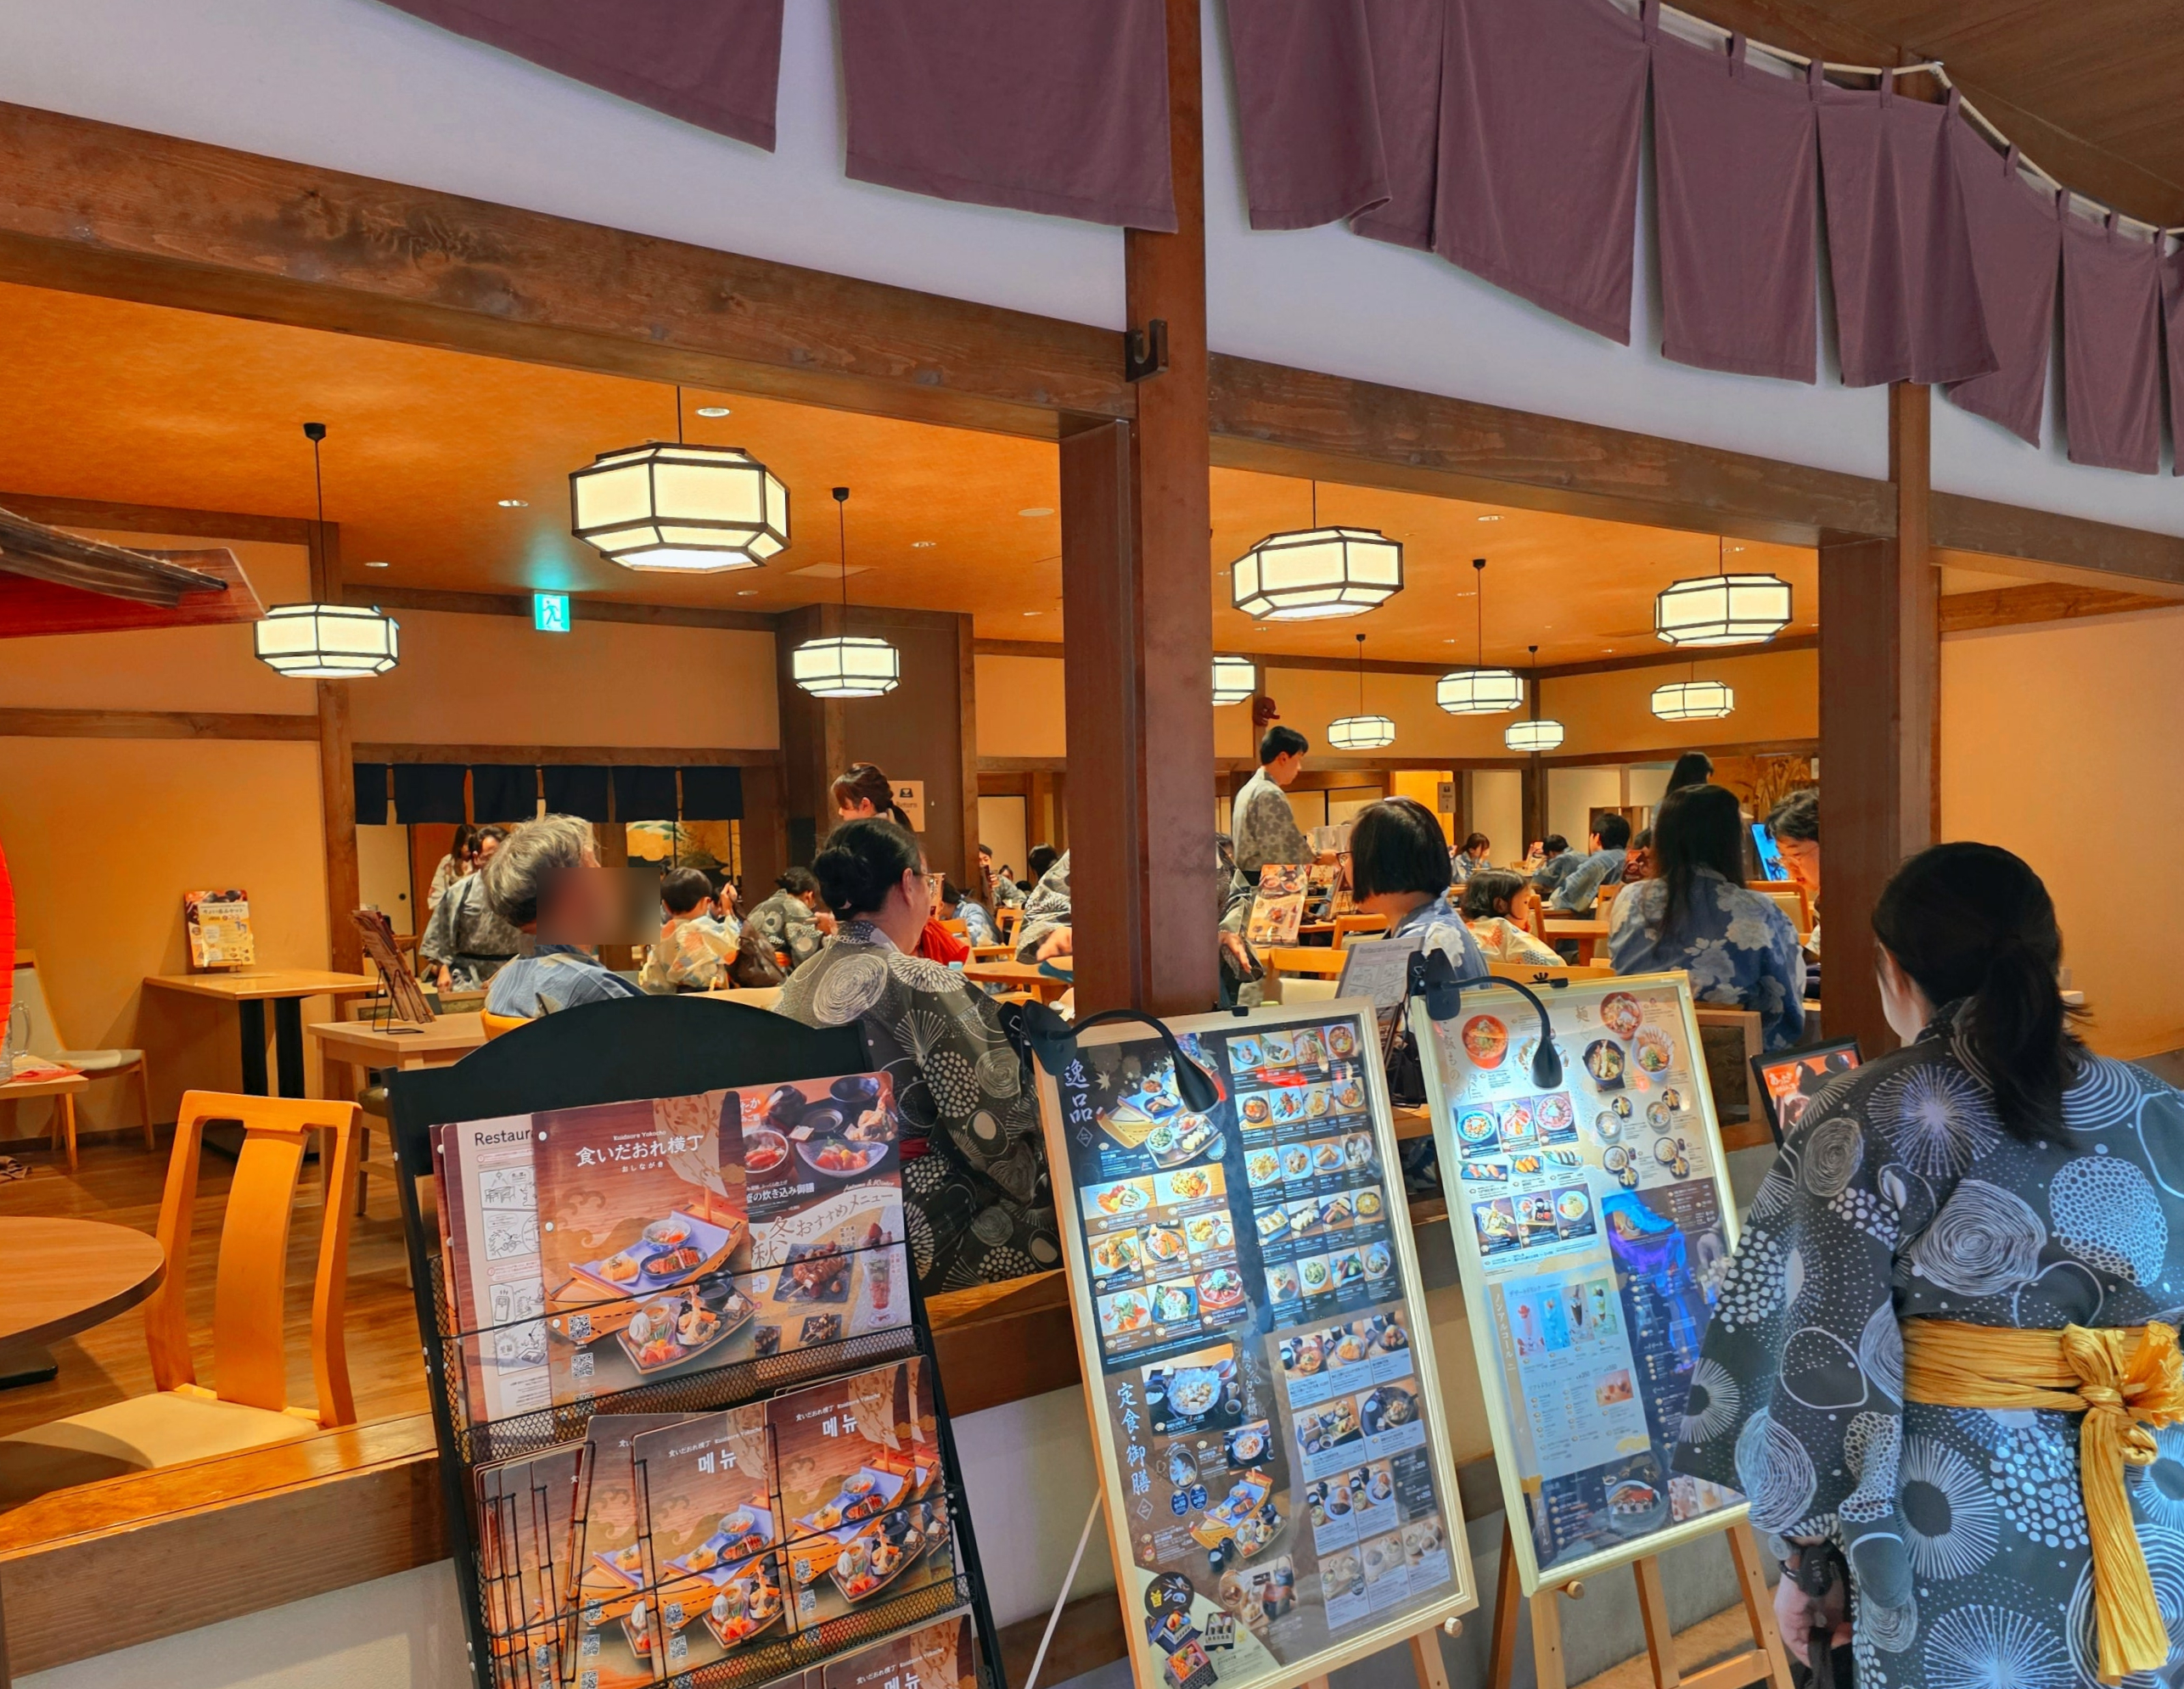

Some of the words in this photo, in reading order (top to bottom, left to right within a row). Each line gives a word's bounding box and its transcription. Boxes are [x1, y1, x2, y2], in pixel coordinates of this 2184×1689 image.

[1064, 1058, 1093, 1124] 逸品
[576, 1135, 704, 1167] 食いだおれ横丁
[621, 1161, 665, 1173] おしながき
[1495, 1293, 1513, 1359] ノンアルコール
[822, 1414, 857, 1437] 메뉴
[1117, 1382, 1152, 1495] 定食・御膳
[698, 1449, 737, 1473] 메뉴
